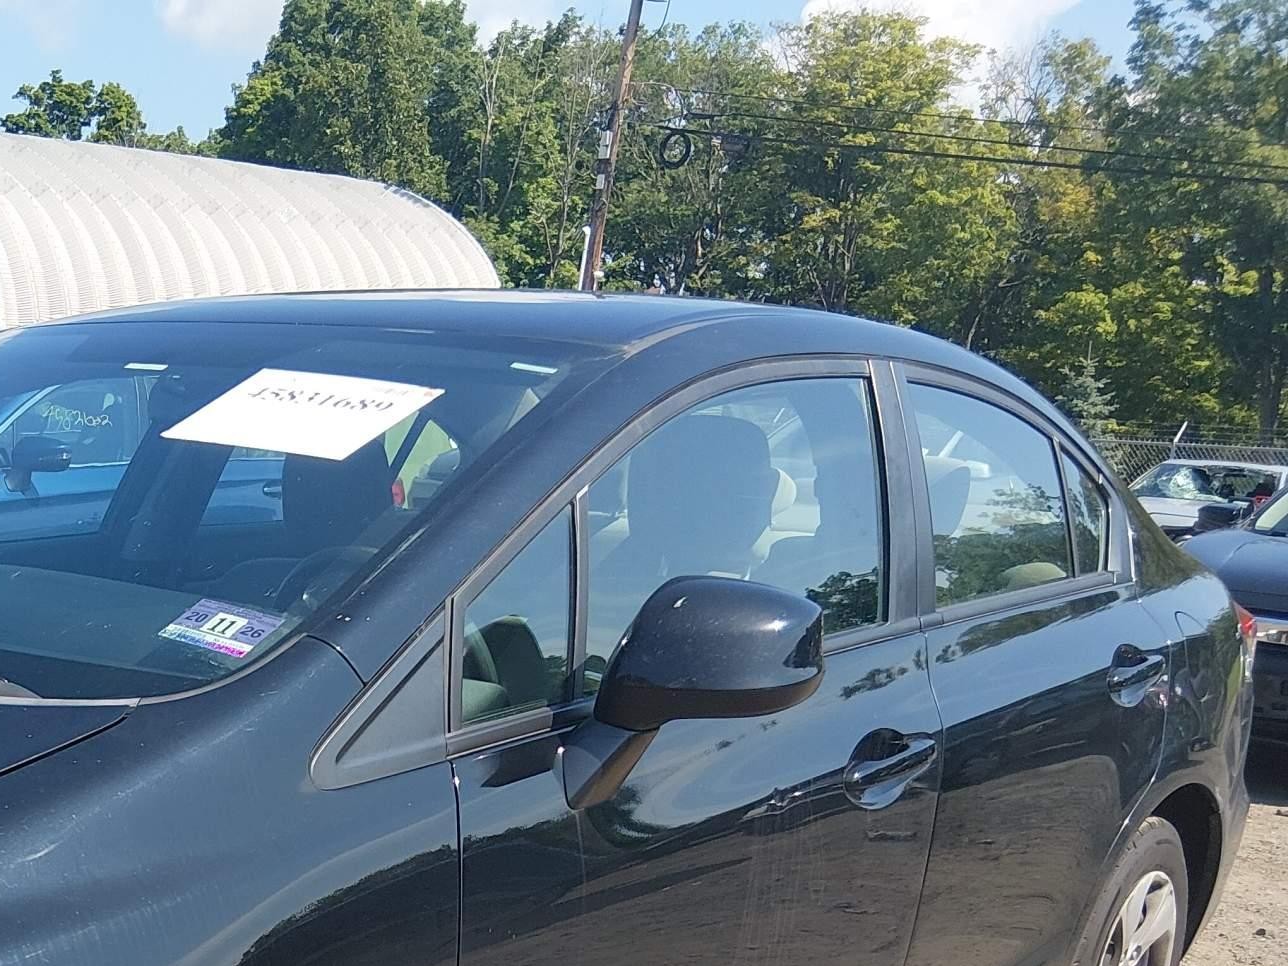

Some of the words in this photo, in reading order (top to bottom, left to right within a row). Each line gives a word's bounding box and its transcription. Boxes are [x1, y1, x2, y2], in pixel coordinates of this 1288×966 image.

[185, 611, 209, 623] 20
[207, 617, 238, 635] 11
[239, 625, 265, 639] 26
